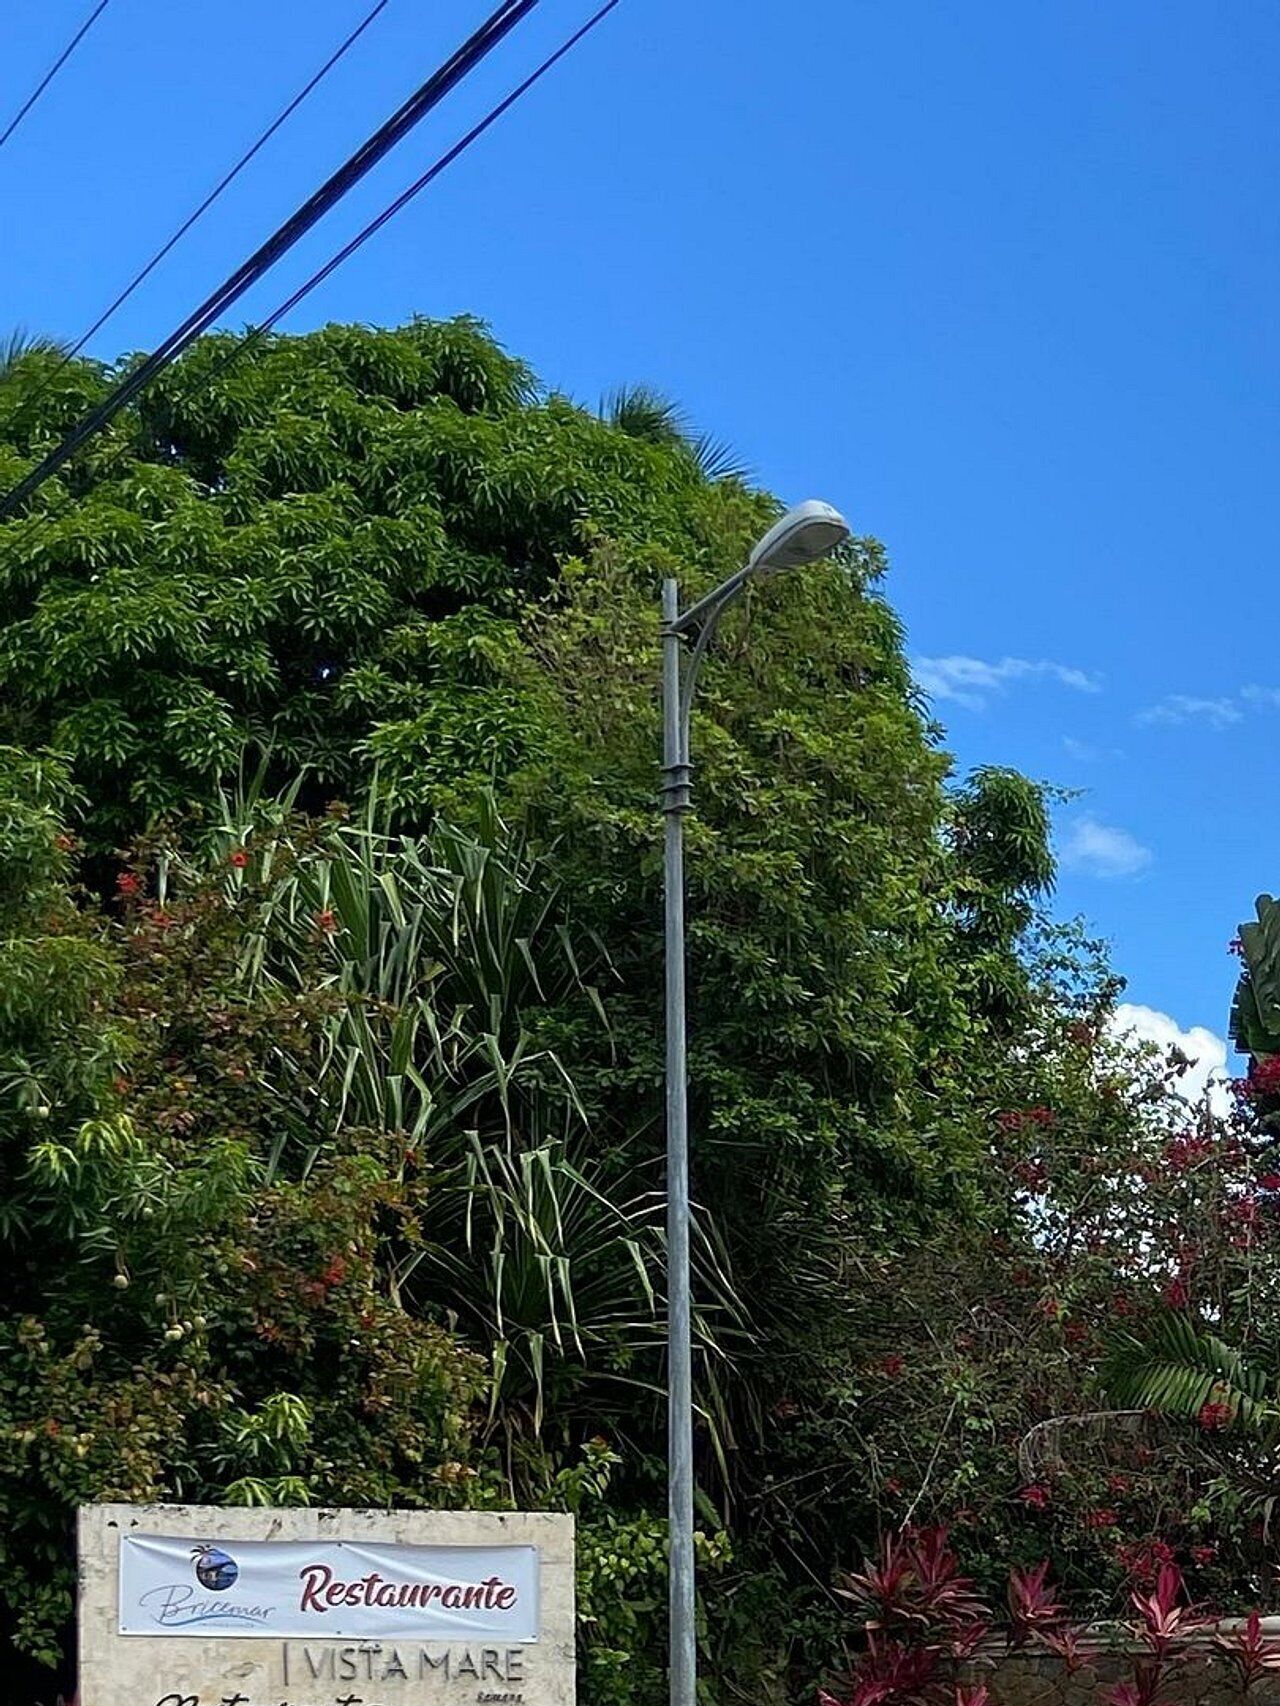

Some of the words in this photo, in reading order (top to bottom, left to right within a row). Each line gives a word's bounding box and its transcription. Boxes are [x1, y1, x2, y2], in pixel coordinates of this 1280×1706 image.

[300, 1564, 517, 1612] Restaurante
[304, 1647, 408, 1681] VISTA
[418, 1647, 524, 1681] MARE
